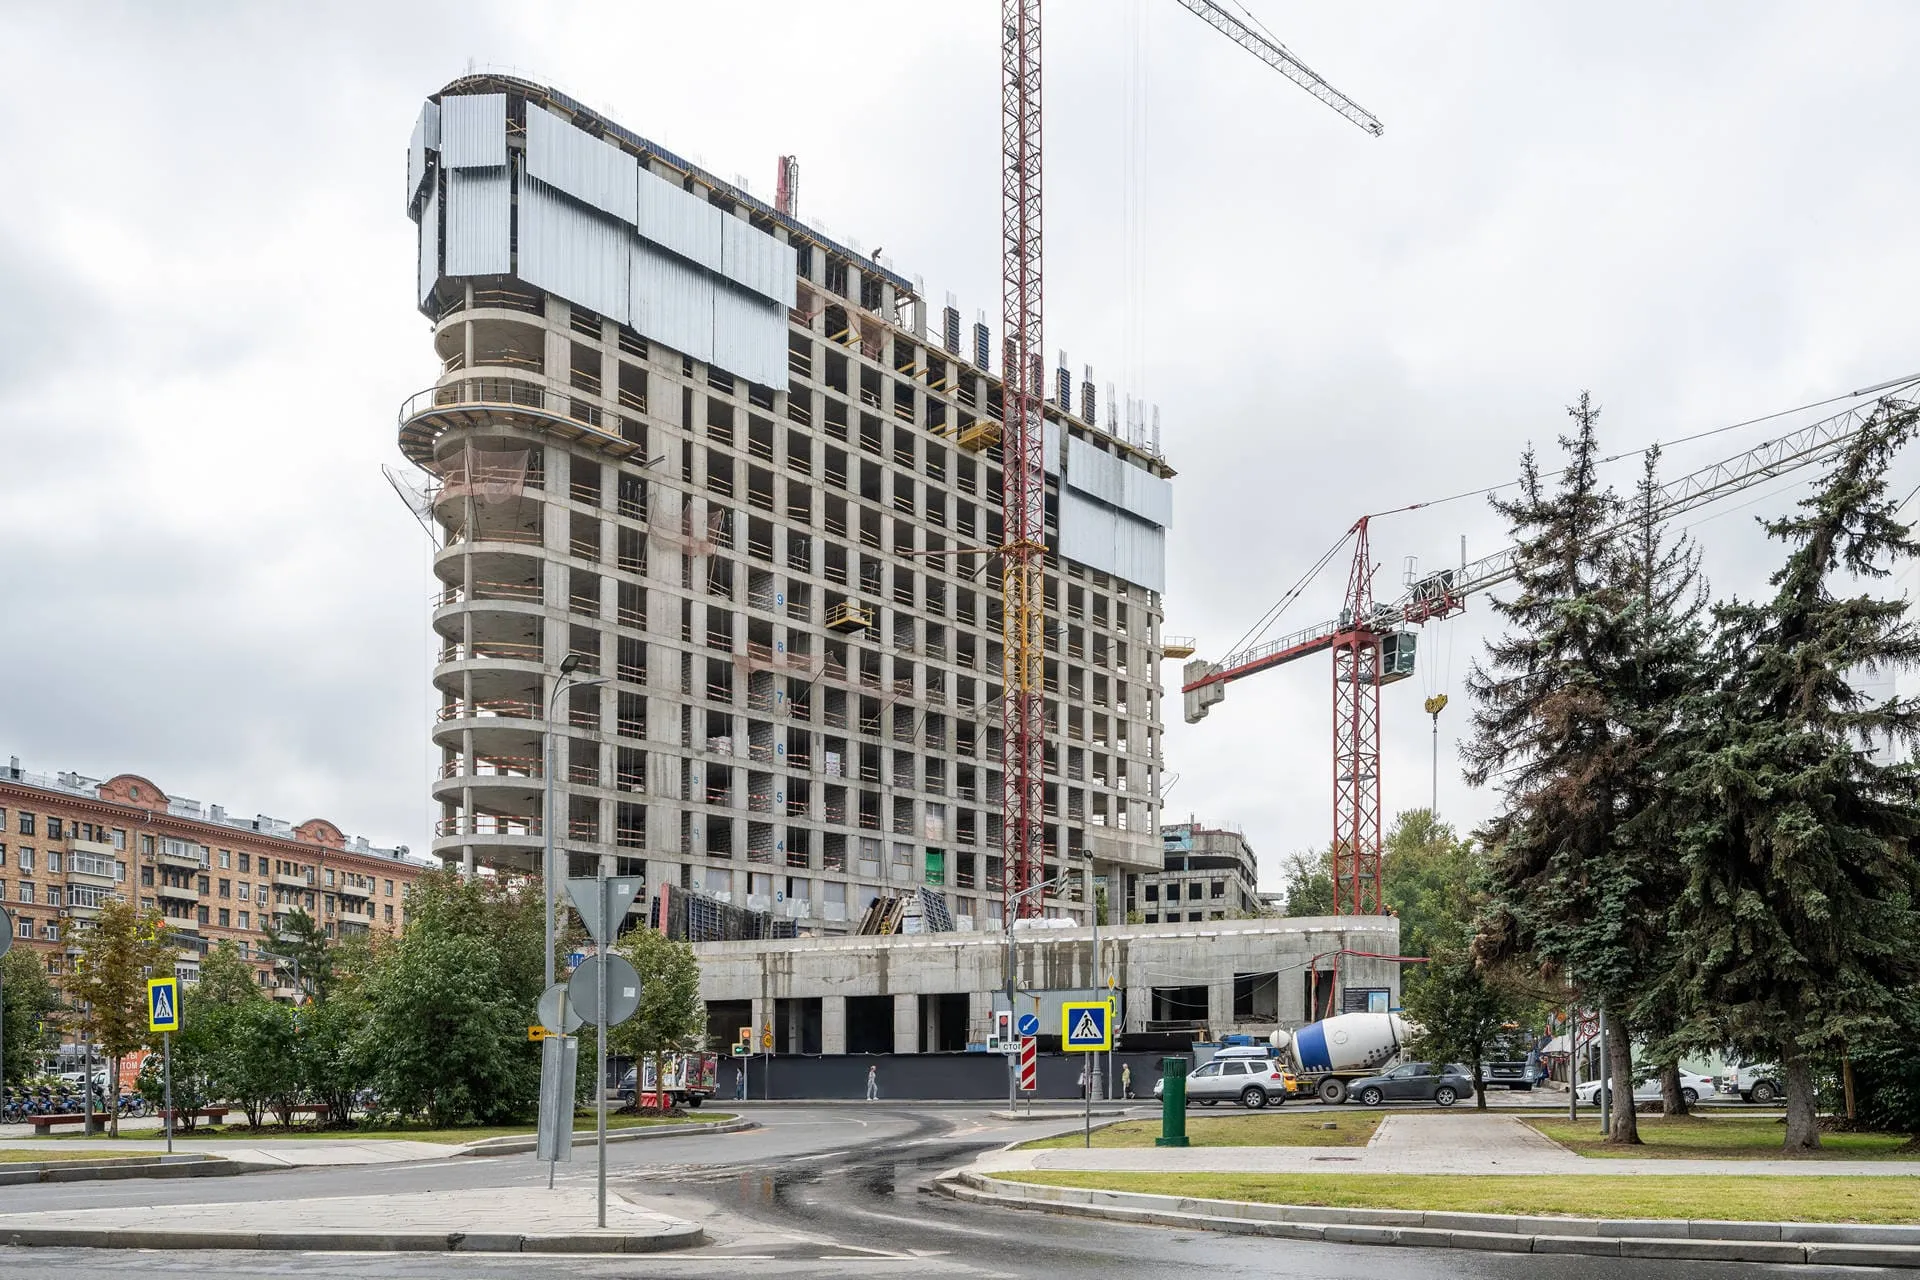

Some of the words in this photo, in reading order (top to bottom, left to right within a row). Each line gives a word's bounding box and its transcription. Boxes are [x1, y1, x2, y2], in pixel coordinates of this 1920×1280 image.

[777, 594, 784, 606] 9
[777, 642, 784, 653] 8
[777, 692, 784, 703] 7
[777, 744, 784, 755] 6
[694, 776, 699, 784] 5
[777, 792, 783, 803] 5
[777, 841, 784, 852] 4
[777, 891, 783, 902] 3
